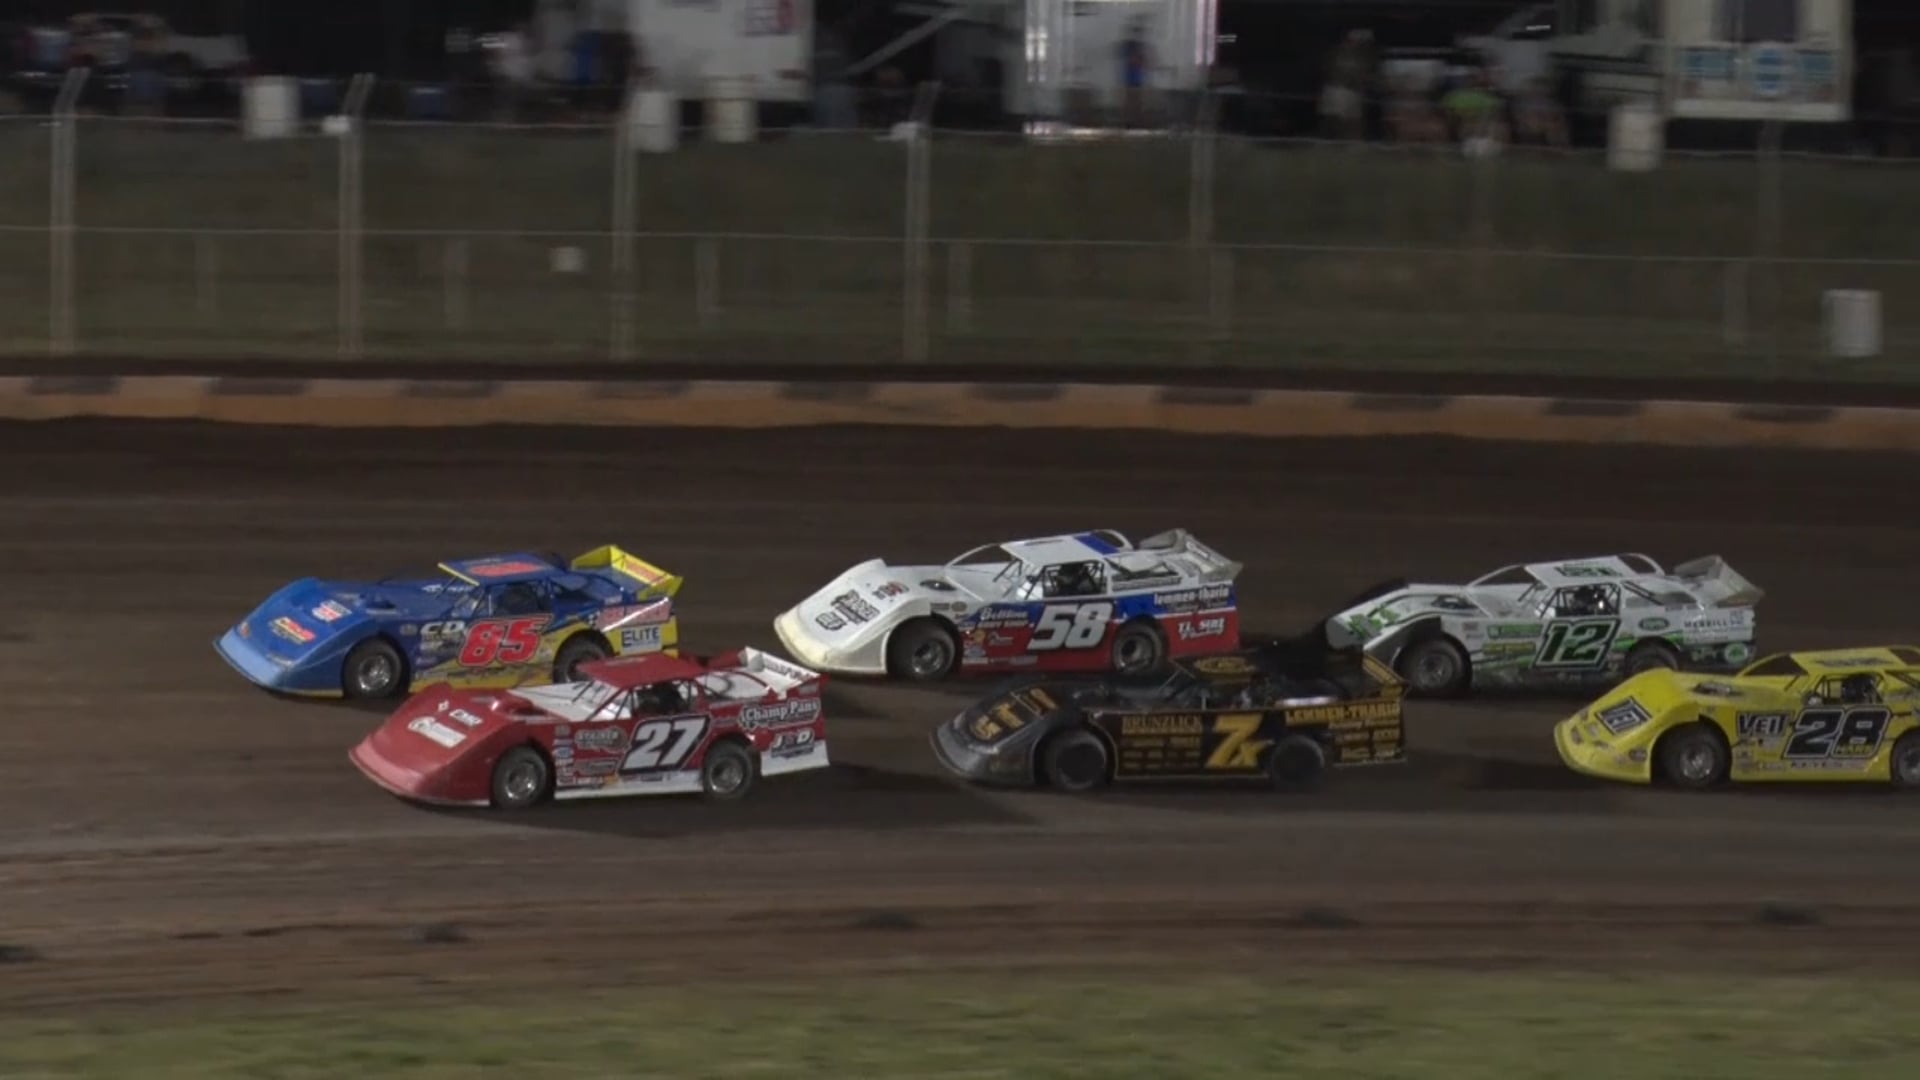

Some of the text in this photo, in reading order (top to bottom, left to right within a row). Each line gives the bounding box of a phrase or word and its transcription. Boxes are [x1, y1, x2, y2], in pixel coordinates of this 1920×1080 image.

[460, 618, 549, 666] 85
[622, 627, 660, 647] ELITE
[1027, 602, 1113, 650] 58
[1538, 620, 1616, 666] 12
[746, 706, 788, 721] Champ
[1784, 708, 1891, 758] 28
[620, 716, 709, 772] 27
